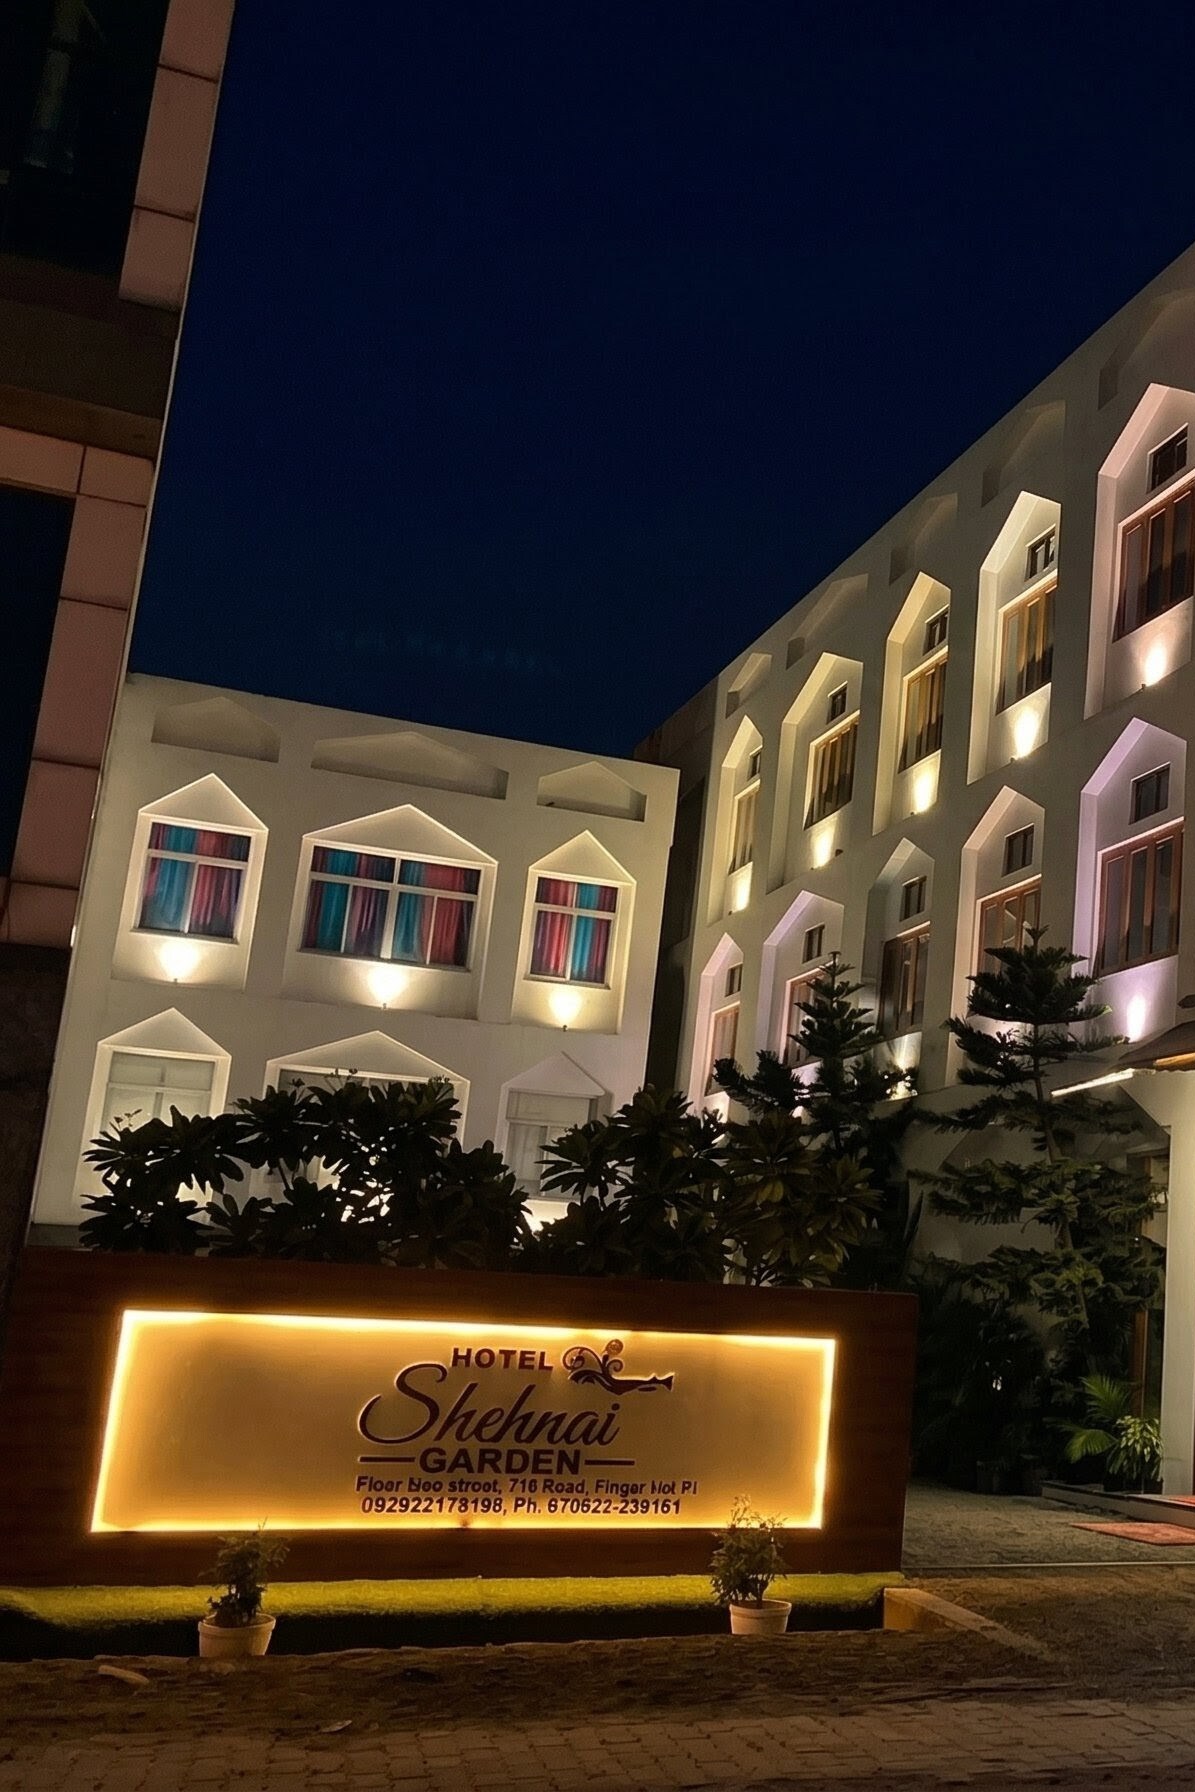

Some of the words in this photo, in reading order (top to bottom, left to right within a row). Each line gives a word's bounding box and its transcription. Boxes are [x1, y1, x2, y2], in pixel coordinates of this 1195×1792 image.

[451, 1347, 553, 1371] HOTEL
[358, 1362, 621, 1446] Shehnai
[419, 1447, 581, 1475] GARDEN
[542, 1478, 589, 1496] Road,
[594, 1479, 646, 1498] Finger
[513, 1496, 541, 1514] Ph.
